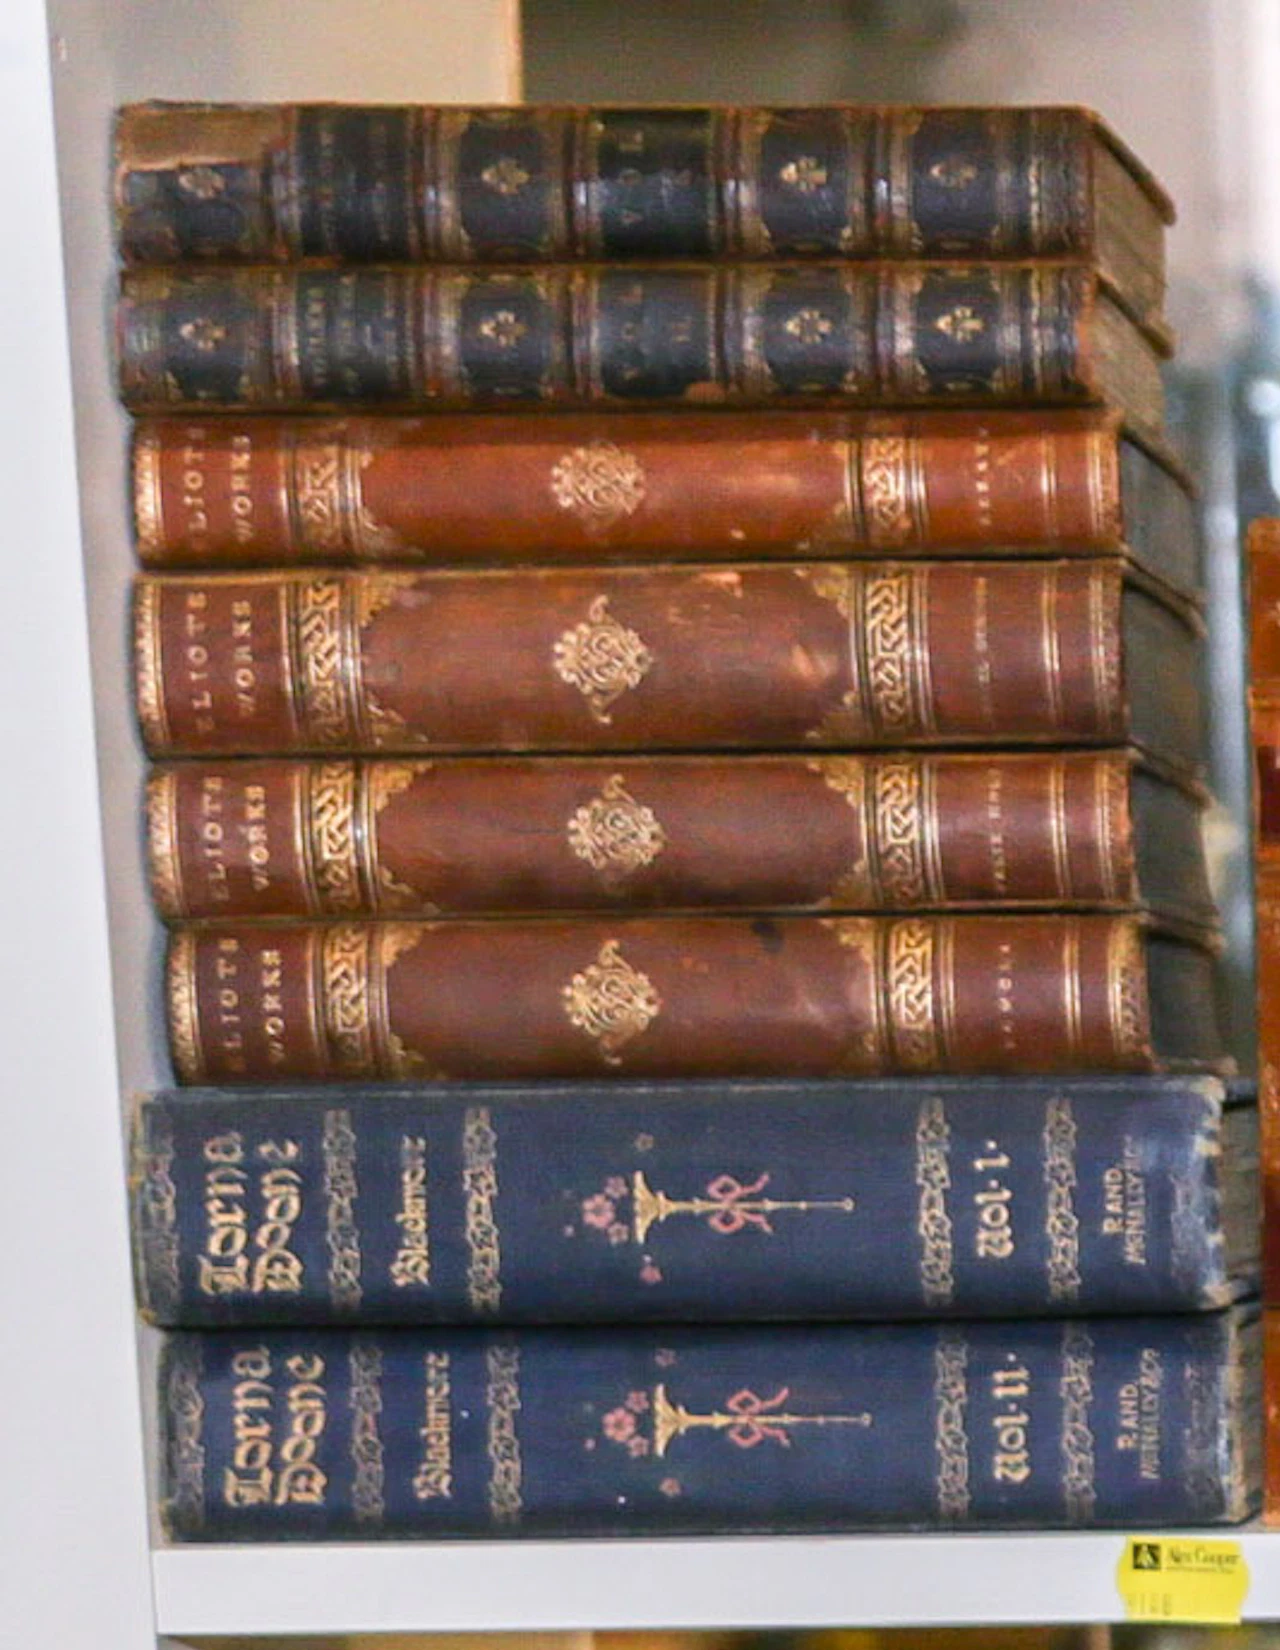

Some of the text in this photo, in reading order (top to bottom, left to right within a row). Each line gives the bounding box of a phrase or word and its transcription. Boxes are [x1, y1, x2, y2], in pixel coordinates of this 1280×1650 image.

[244, 785, 271, 891] WORKS
[260, 950, 286, 1064] WORKS
[198, 1131, 250, 1295] Lorna
[253, 1138, 303, 1294] Doone
[224, 1345, 274, 1508] Lorna
[275, 1352, 328, 1507] Doone
